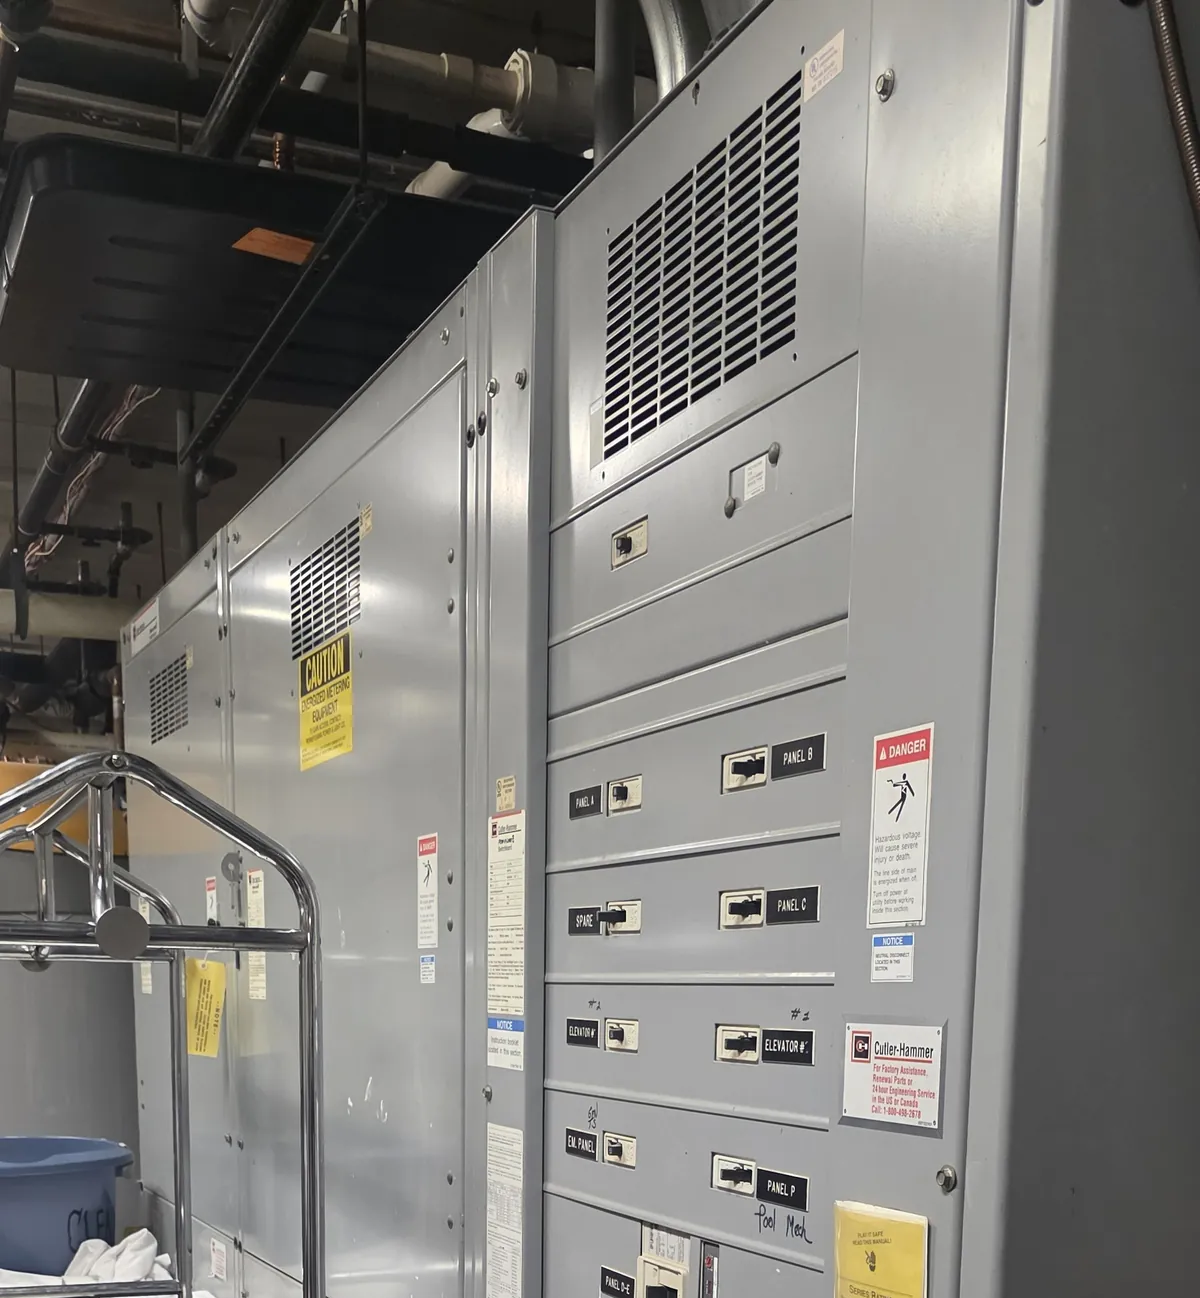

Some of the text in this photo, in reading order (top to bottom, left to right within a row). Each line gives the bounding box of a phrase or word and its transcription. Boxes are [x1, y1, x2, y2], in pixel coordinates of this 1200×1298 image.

[306, 638, 344, 692] CAUTION
[783, 746, 813, 766] PANEL B
[889, 738, 926, 759] DANGER
[575, 794, 595, 809] PANEL A
[875, 833, 900, 843] Hazardous
[777, 897, 807, 912] PANEL C
[575, 914, 594, 928] SPARE
[882, 936, 904, 946] NOTICE
[496, 1020, 513, 1030] NOTICE
[569, 1025, 590, 1038] ELEVATOR
[765, 1038, 799, 1053] ELEVATOR
[874, 1041, 934, 1059] Cutler-Hammer
[873, 1063, 881, 1073] For
[881, 1064, 899, 1076] Factory
[872, 1073, 893, 1085] Renewal
[894, 1075, 907, 1086] Parts
[872, 1084, 878, 1093] 24
[889, 1086, 917, 1099] Engineering
[917, 1088, 936, 1100] Service
[872, 1095, 877, 1103] in
[877, 1095, 885, 1104] the
[886, 1096, 893, 1105] US
[900, 1097, 919, 1109] Canada
[568, 1135, 595, 1153] EM. PANEL
[767, 1179, 796, 1198] PANEL P
[754, 1203, 813, 1245] Pool Mech
[605, 1275, 620, 1291] PANEL
[849, 1284, 870, 1298] SERIES
